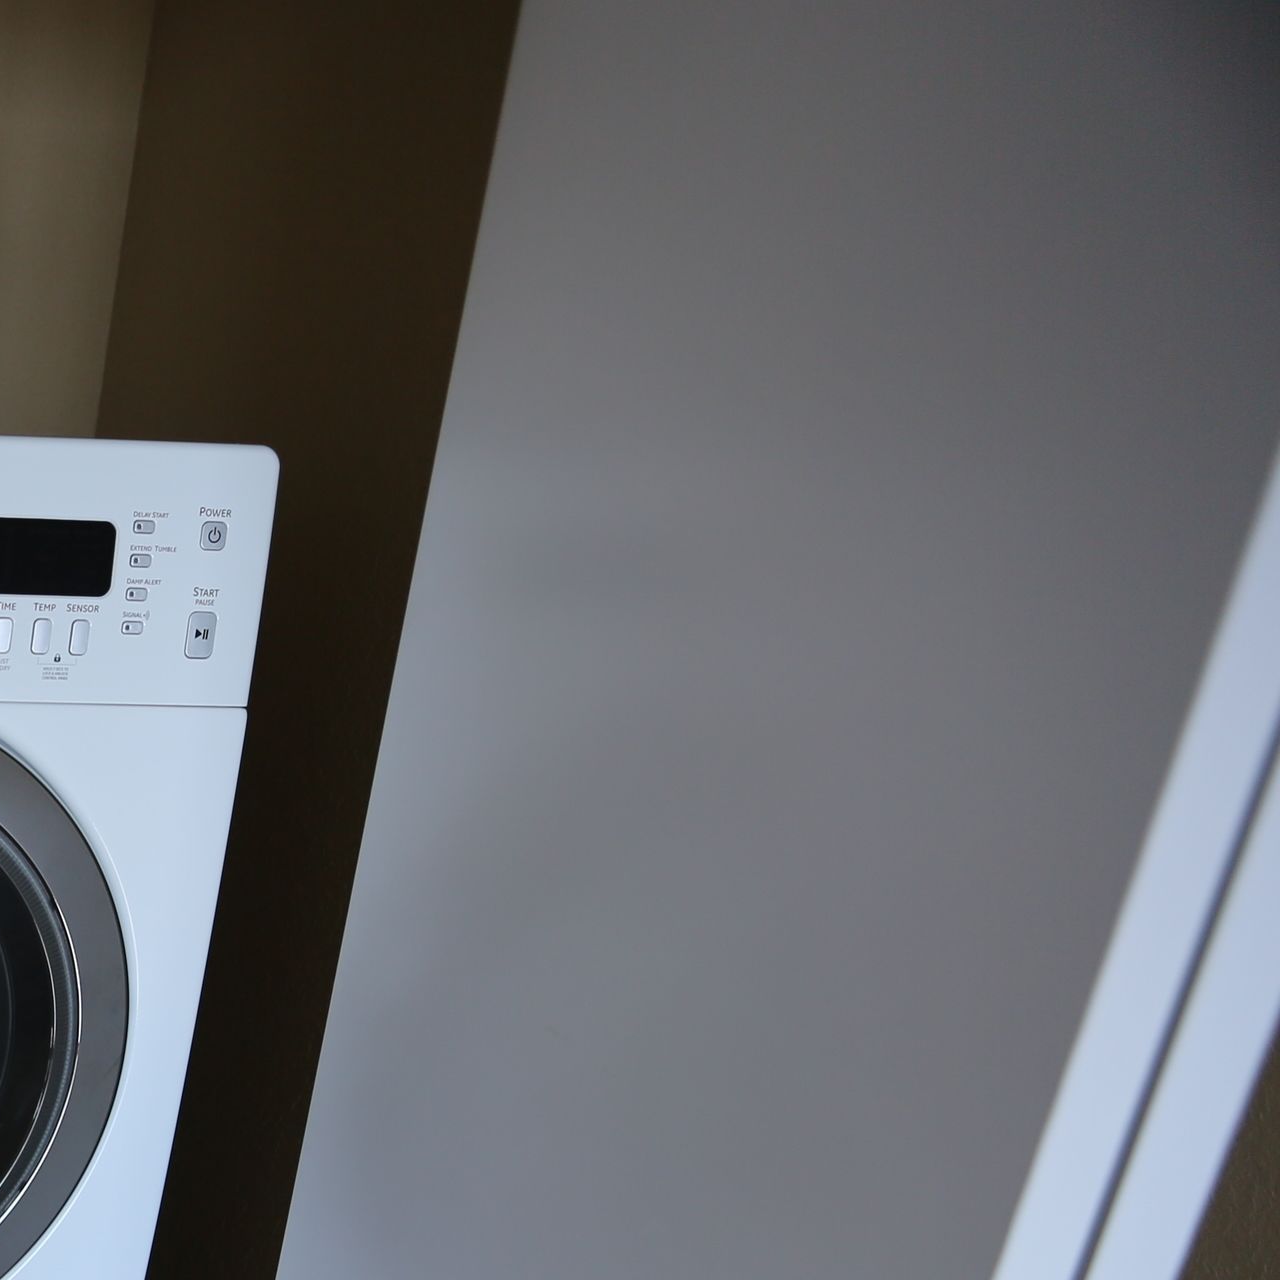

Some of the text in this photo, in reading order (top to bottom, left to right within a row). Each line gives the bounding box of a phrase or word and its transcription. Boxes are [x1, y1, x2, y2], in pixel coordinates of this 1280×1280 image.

[133, 511, 169, 519] DELAY START
[199, 506, 232, 518] POWER
[129, 544, 177, 553] EXTEND TUMBLE
[144, 578, 162, 586] ALERT
[193, 586, 220, 598] START
[33, 602, 57, 613] TEMP
[66, 603, 100, 614] SENSOR
[122, 611, 143, 619] SIGNAL
